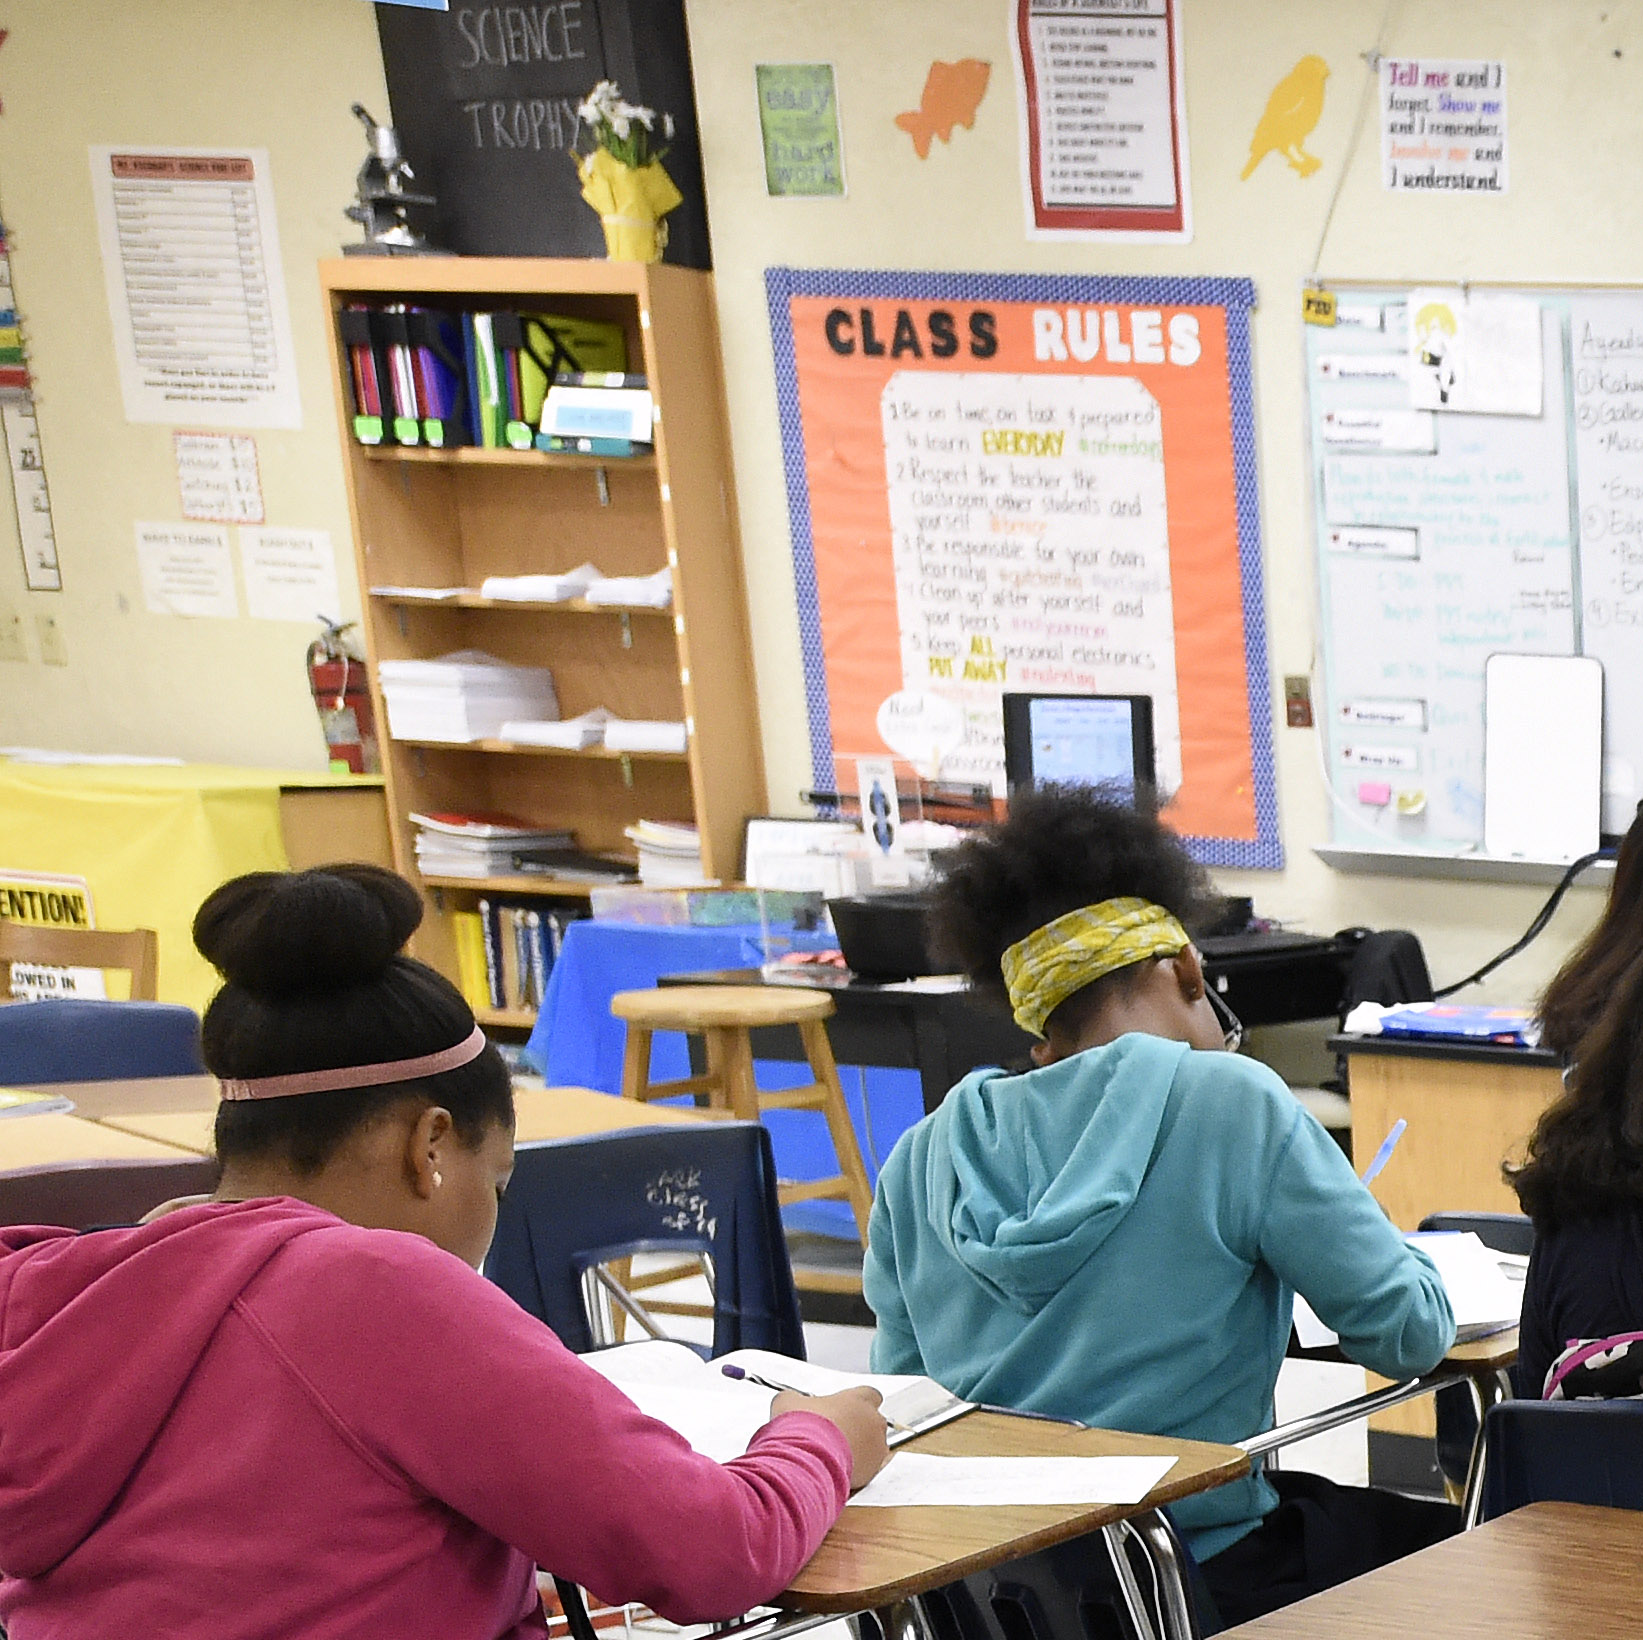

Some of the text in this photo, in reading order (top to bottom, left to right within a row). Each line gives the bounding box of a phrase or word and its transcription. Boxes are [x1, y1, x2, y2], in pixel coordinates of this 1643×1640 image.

[458, 3, 585, 67] SCIENCE
[1389, 62, 1489, 89] Tell me and
[464, 98, 581, 149] TROPHY
[825, 307, 1202, 367] CLASS RULES
[981, 429, 1066, 459] EVERYDAY
[962, 659, 1008, 683] AWAY
